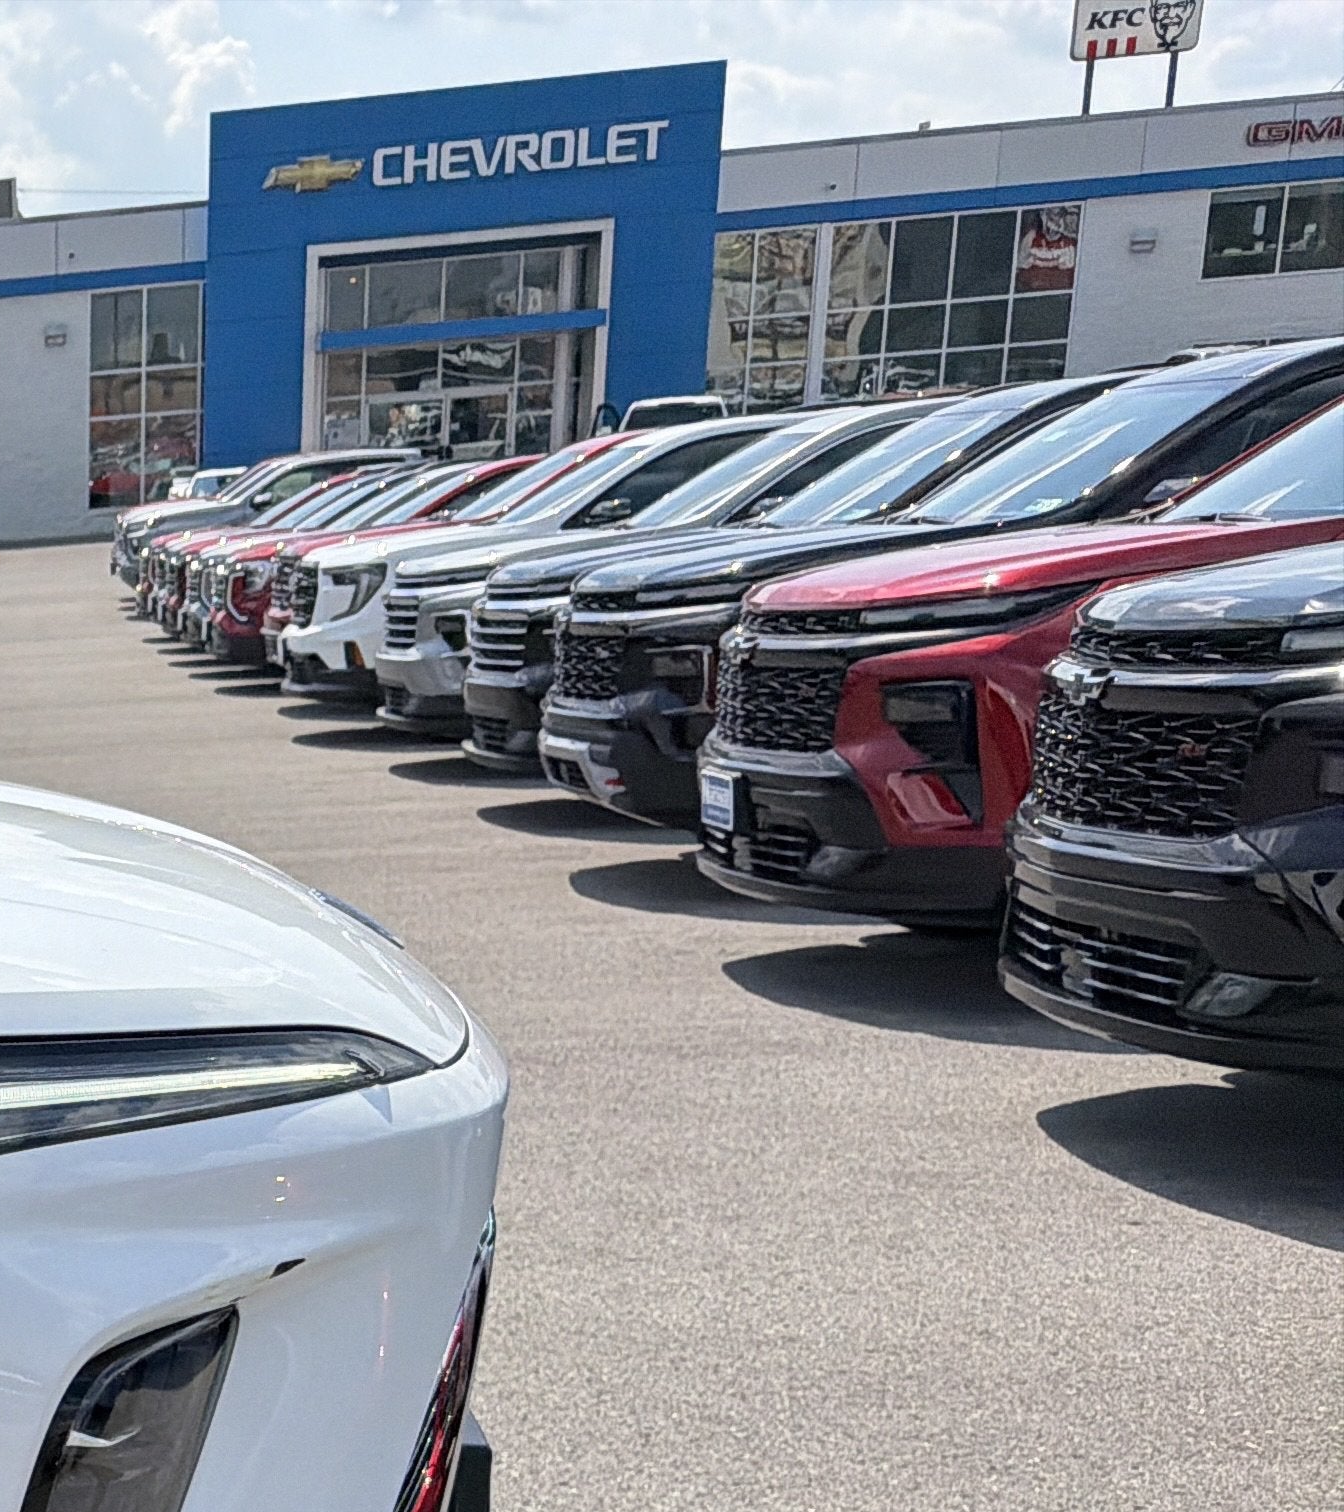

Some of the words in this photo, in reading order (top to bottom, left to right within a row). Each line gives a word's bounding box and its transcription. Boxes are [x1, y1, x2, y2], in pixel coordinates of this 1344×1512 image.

[1085, 7, 1146, 31] KFC
[1246, 115, 1344, 148] GM
[372, 119, 670, 187] CHEVROLET
